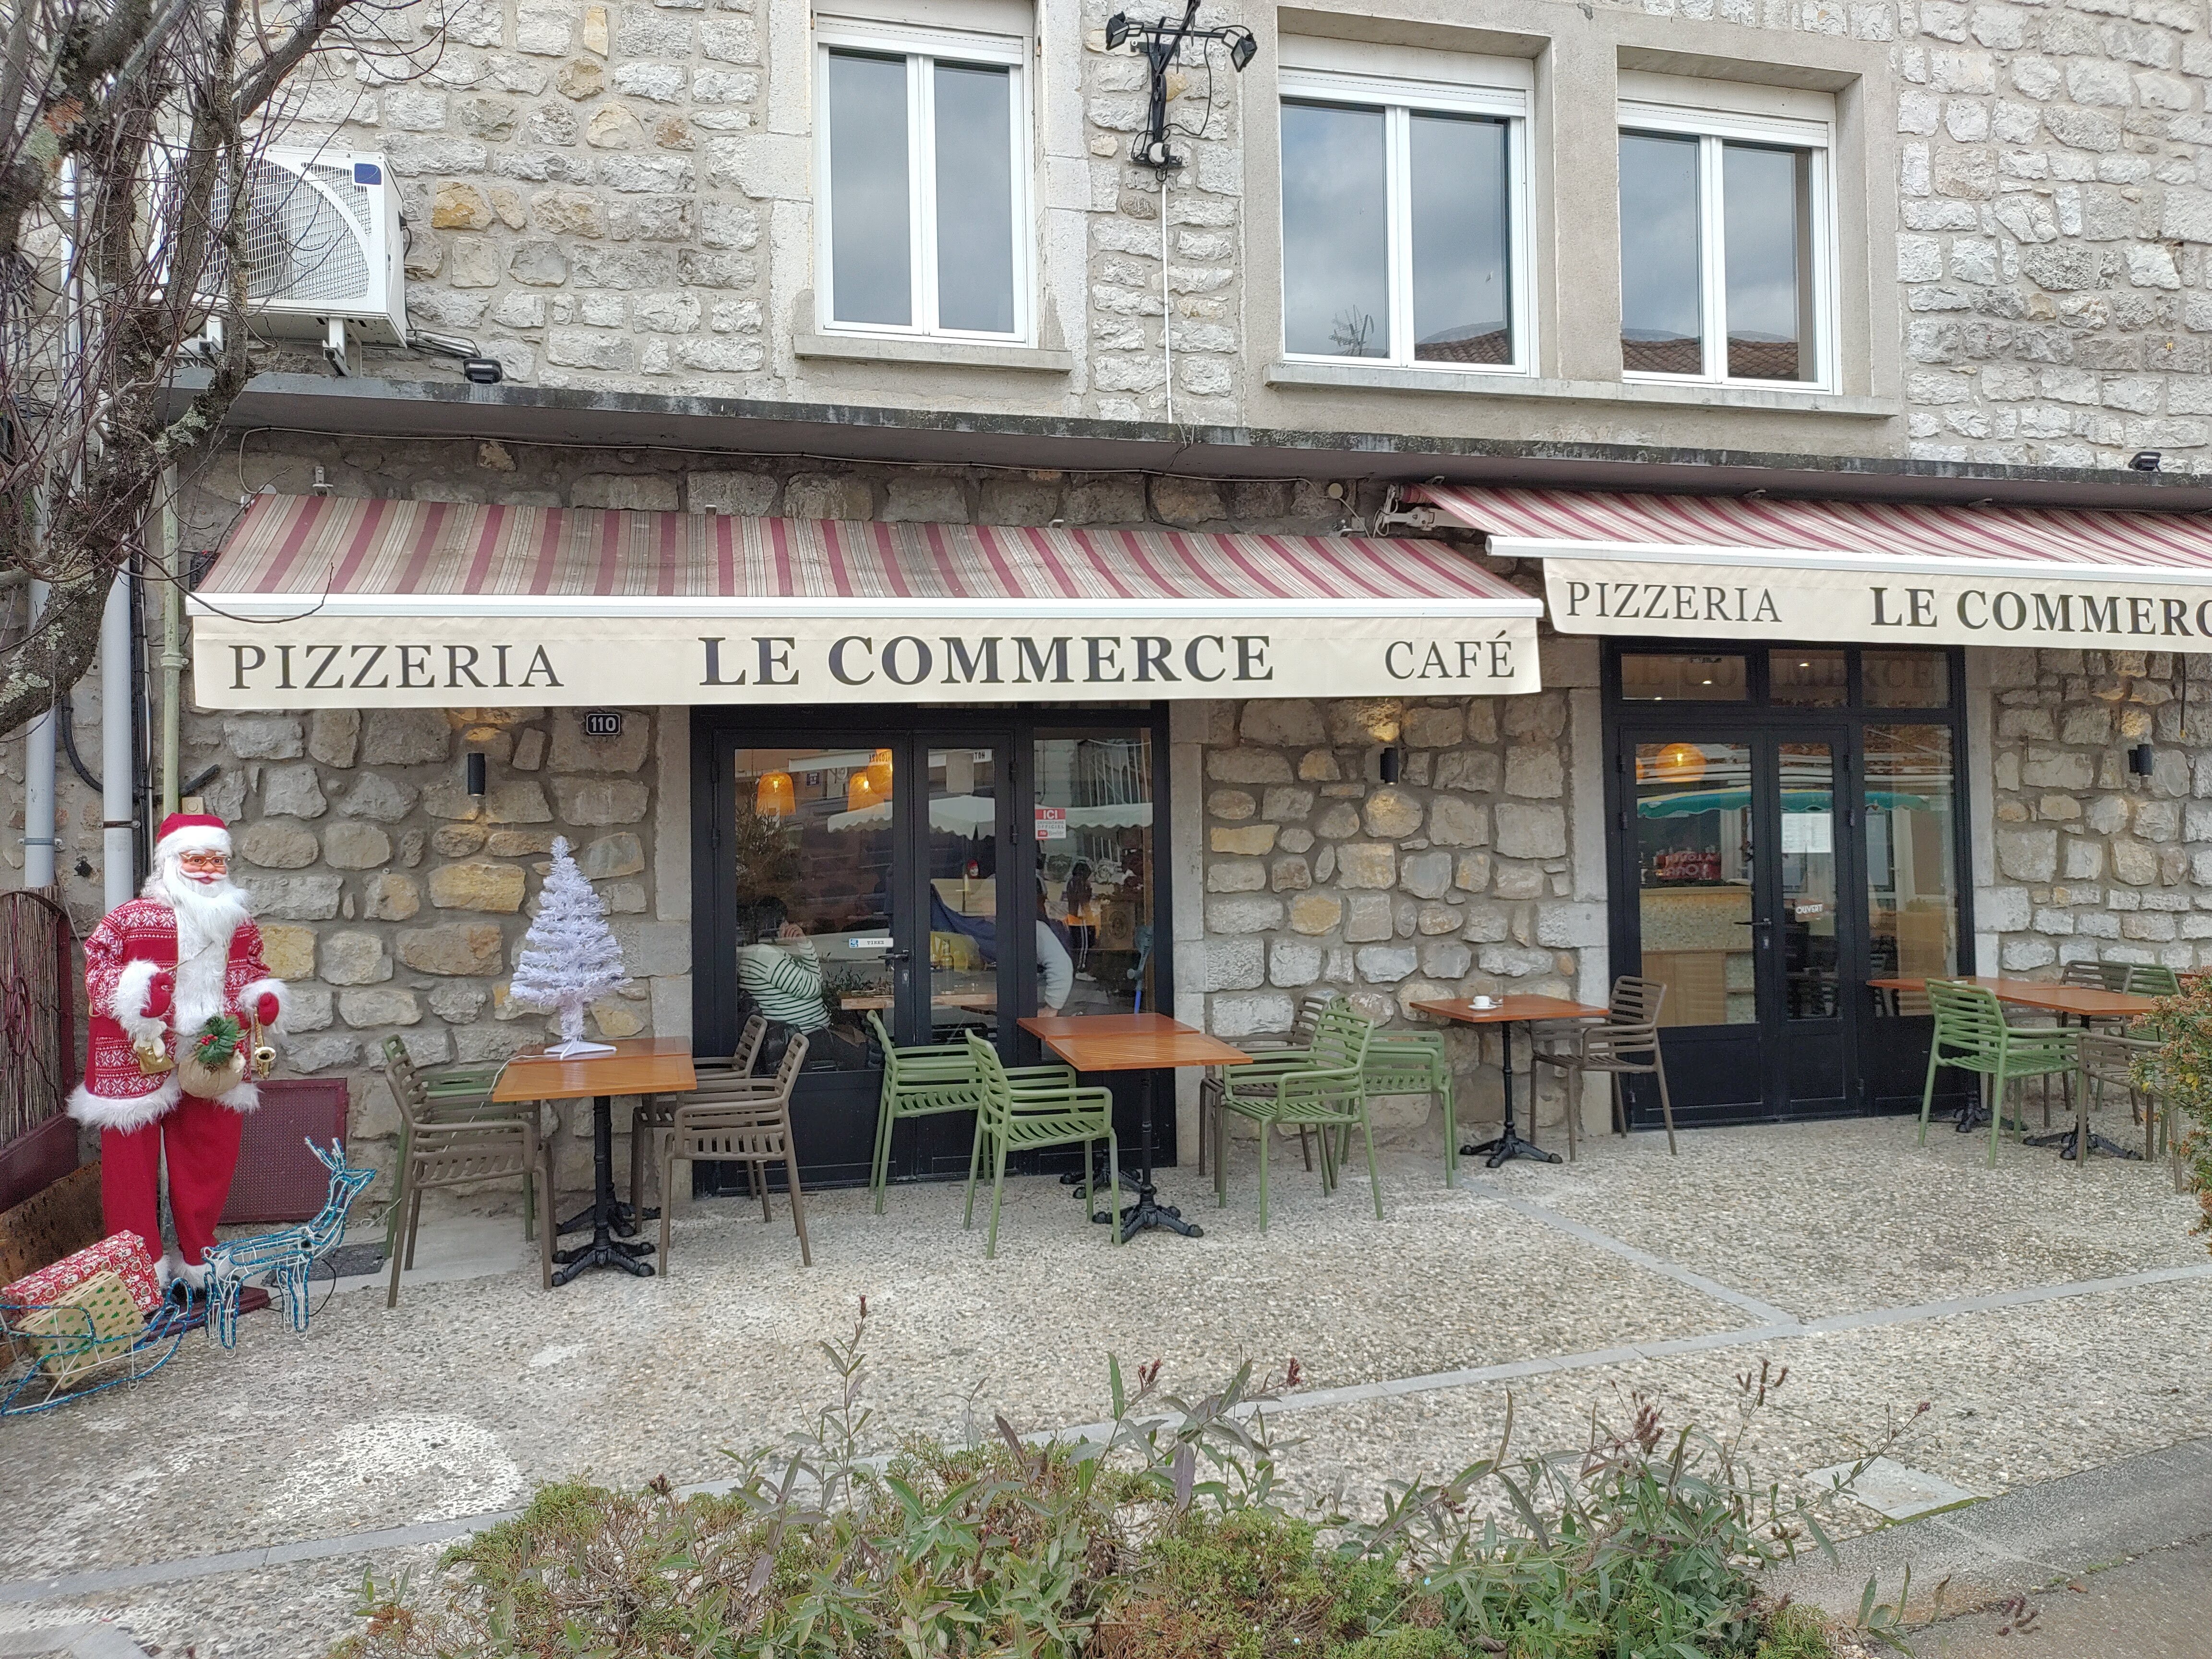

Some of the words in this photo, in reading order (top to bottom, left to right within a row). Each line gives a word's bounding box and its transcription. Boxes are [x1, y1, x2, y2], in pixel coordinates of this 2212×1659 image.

[1566, 581, 1782, 623] PIZZERIA
[1869, 587, 1937, 627] LE
[228, 644, 565, 689] PIZZERIA
[697, 636, 799, 686] LE
[828, 635, 1273, 685] COMMERCE
[1385, 630, 1515, 680] CAFÉ
[591, 717, 616, 732] 110
[1043, 809, 1058, 819] ICI
[1795, 903, 1823, 914] OUVERT
